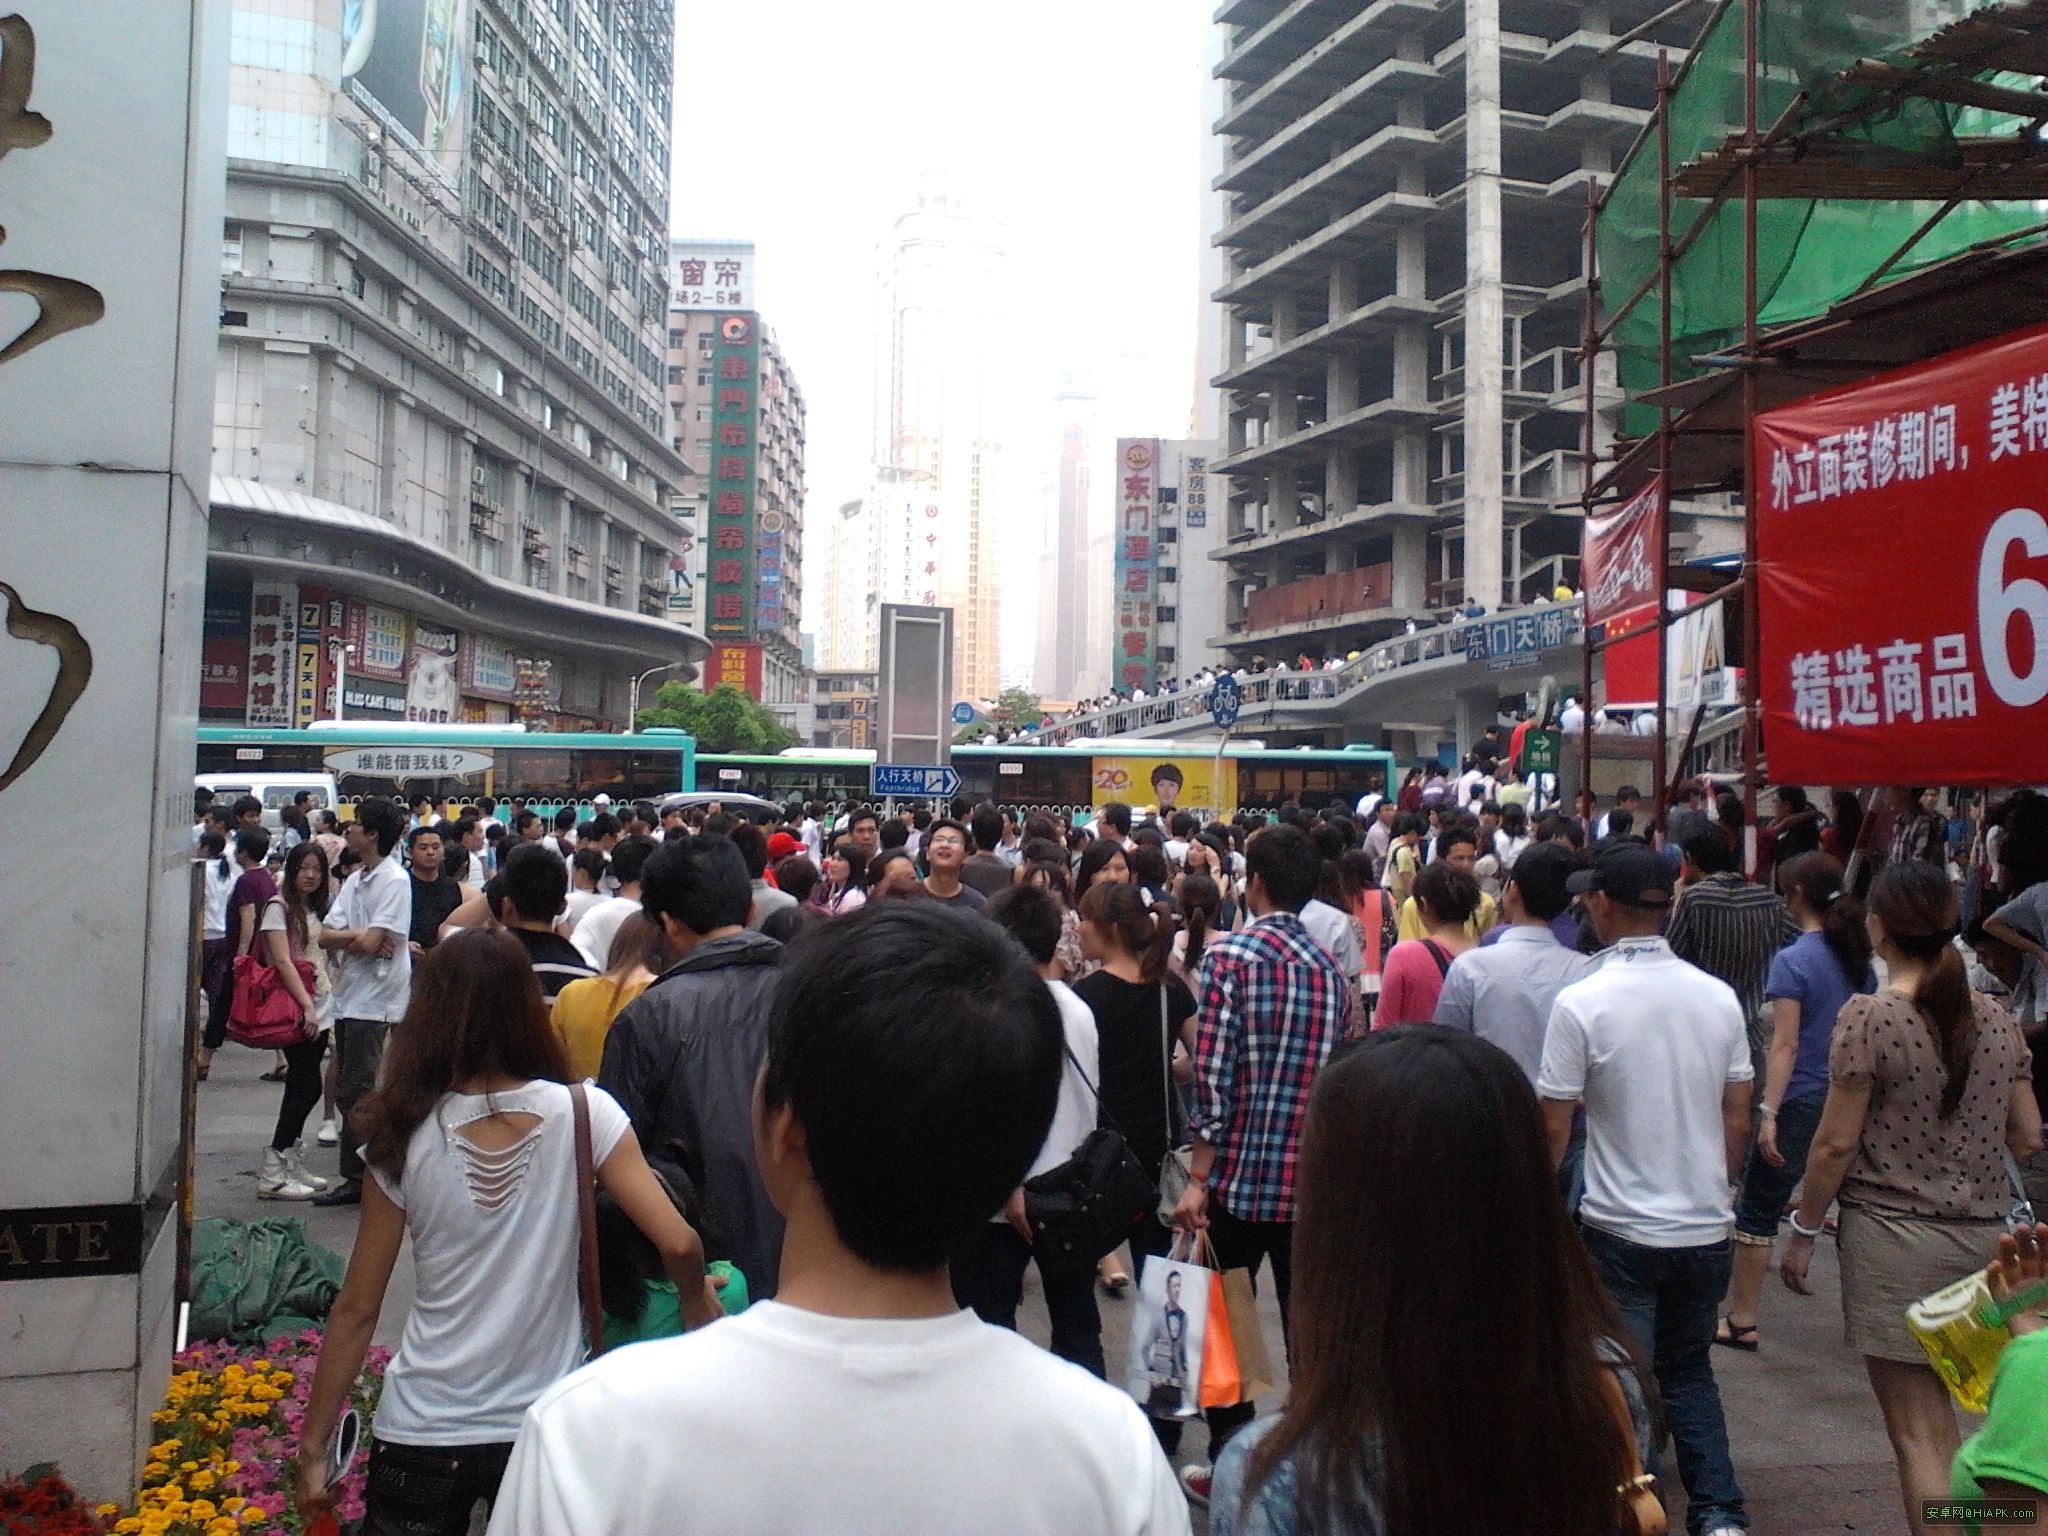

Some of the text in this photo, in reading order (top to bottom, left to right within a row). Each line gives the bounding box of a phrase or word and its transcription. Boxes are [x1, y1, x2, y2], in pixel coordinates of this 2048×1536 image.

[1124, 475, 1151, 591] 东门酒店
[303, 607, 318, 623] 7
[1467, 612, 1564, 659] 东门天桥
[1790, 507, 2048, 731] 精选商品 6
[878, 769, 923, 783] 人行天桥
